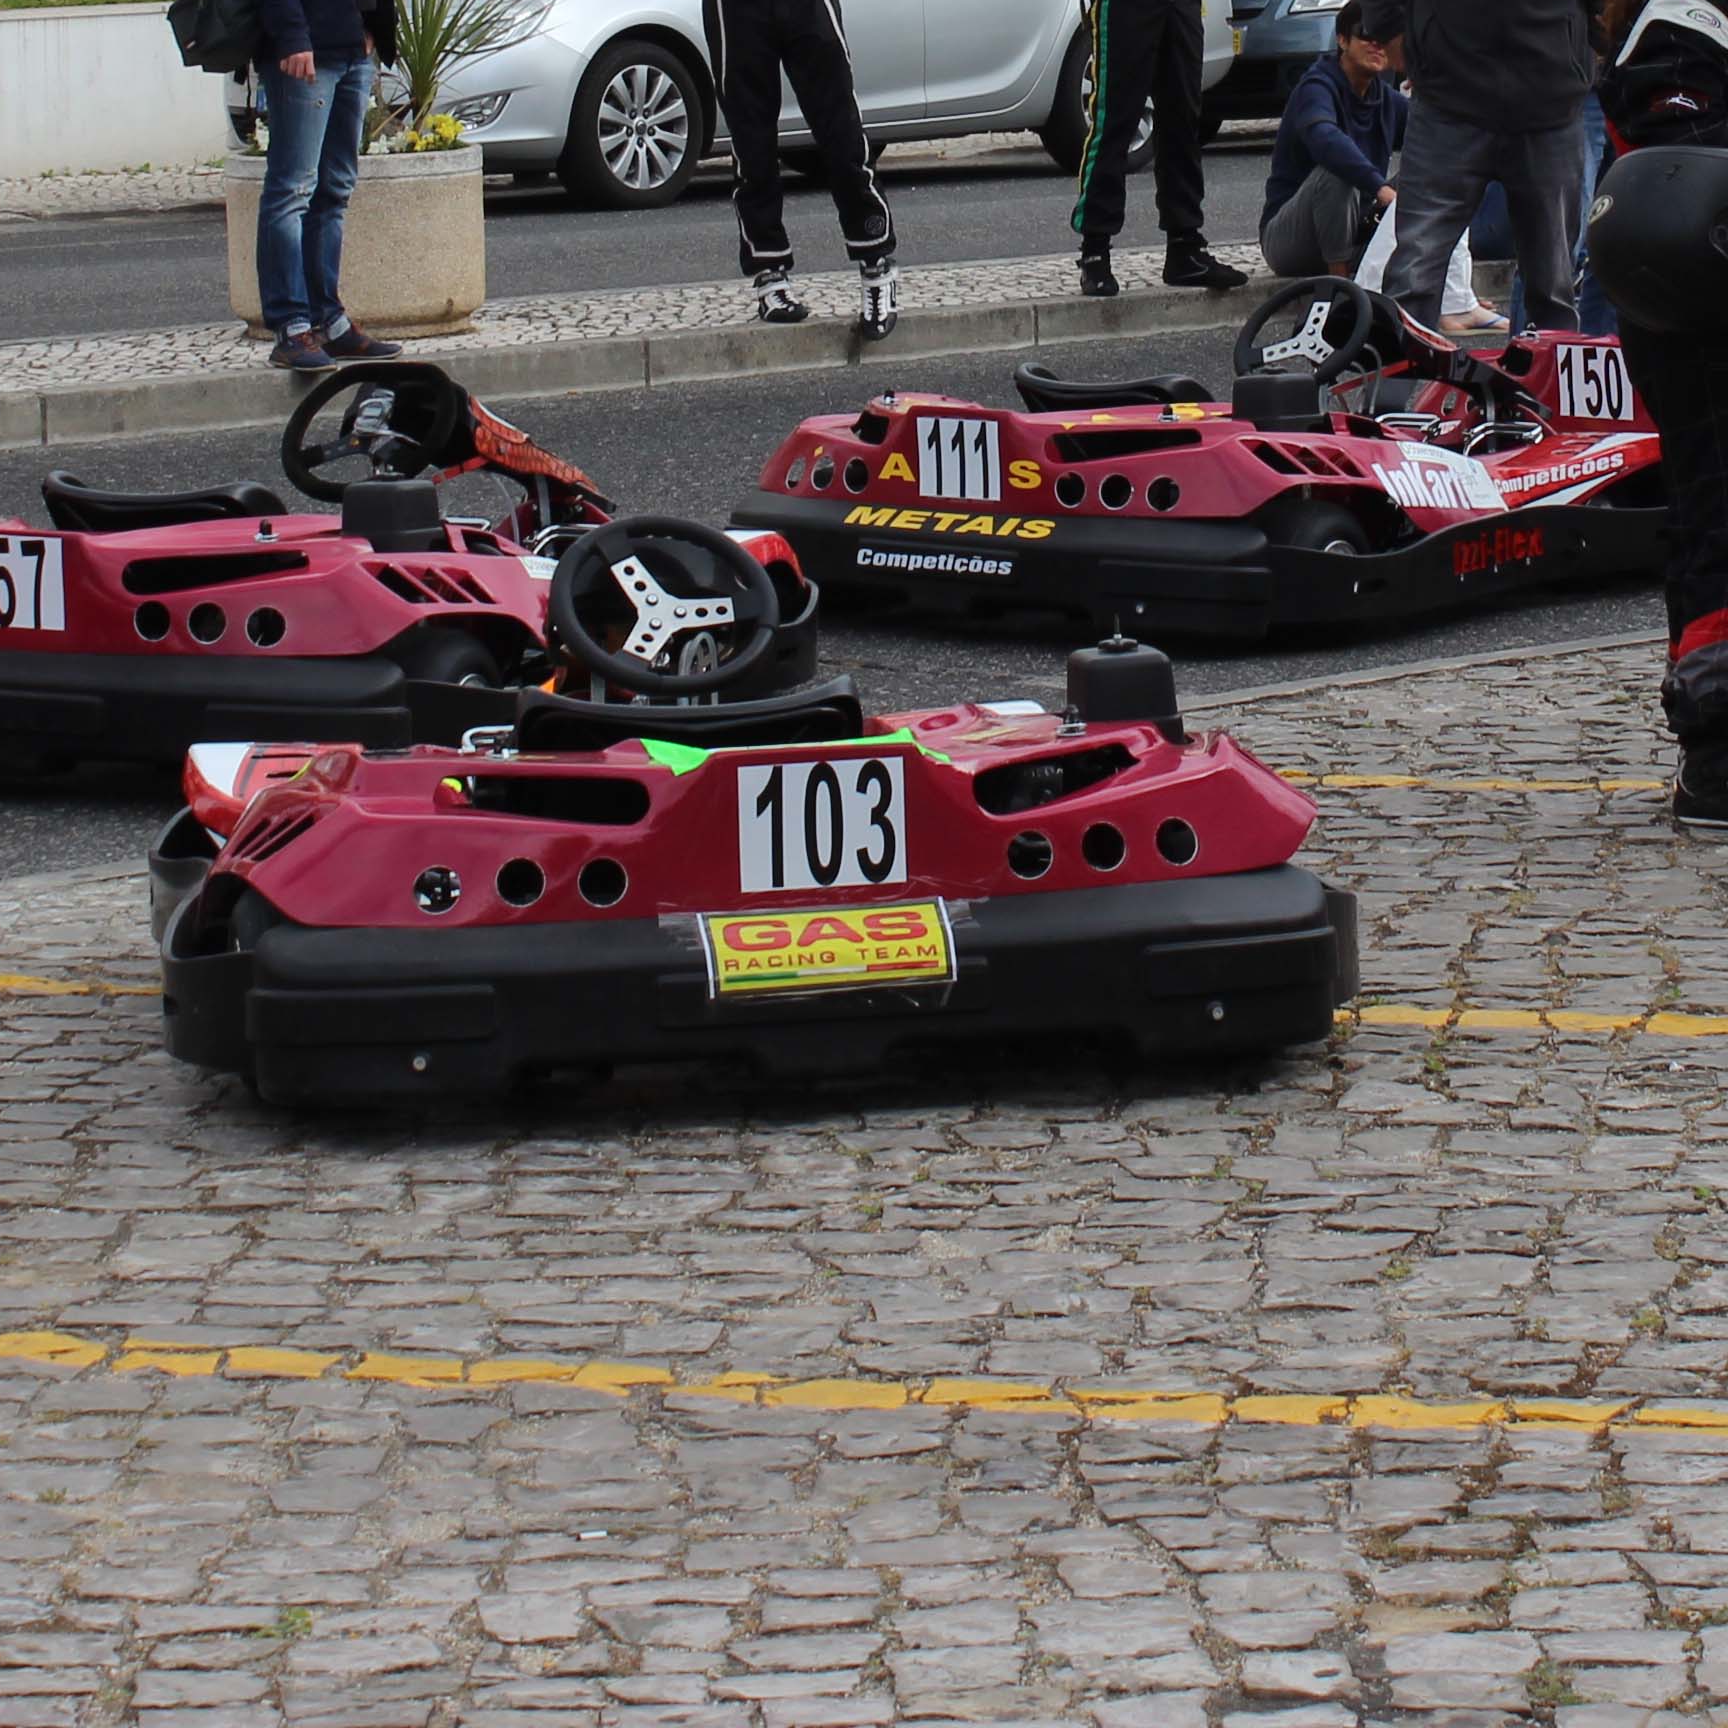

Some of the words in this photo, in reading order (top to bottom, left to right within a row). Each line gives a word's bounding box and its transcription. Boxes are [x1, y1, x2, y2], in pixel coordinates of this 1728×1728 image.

[1560, 346, 1623, 421] 150
[927, 418, 990, 500] 111
[1494, 453, 1625, 494] Competições
[843, 505, 1056, 540] METAIS
[856, 547, 1014, 576] Competições
[755, 758, 896, 888] 103
[723, 911, 928, 952] GAS
[724, 951, 836, 973] RACING
[856, 944, 939, 963] TEAM
